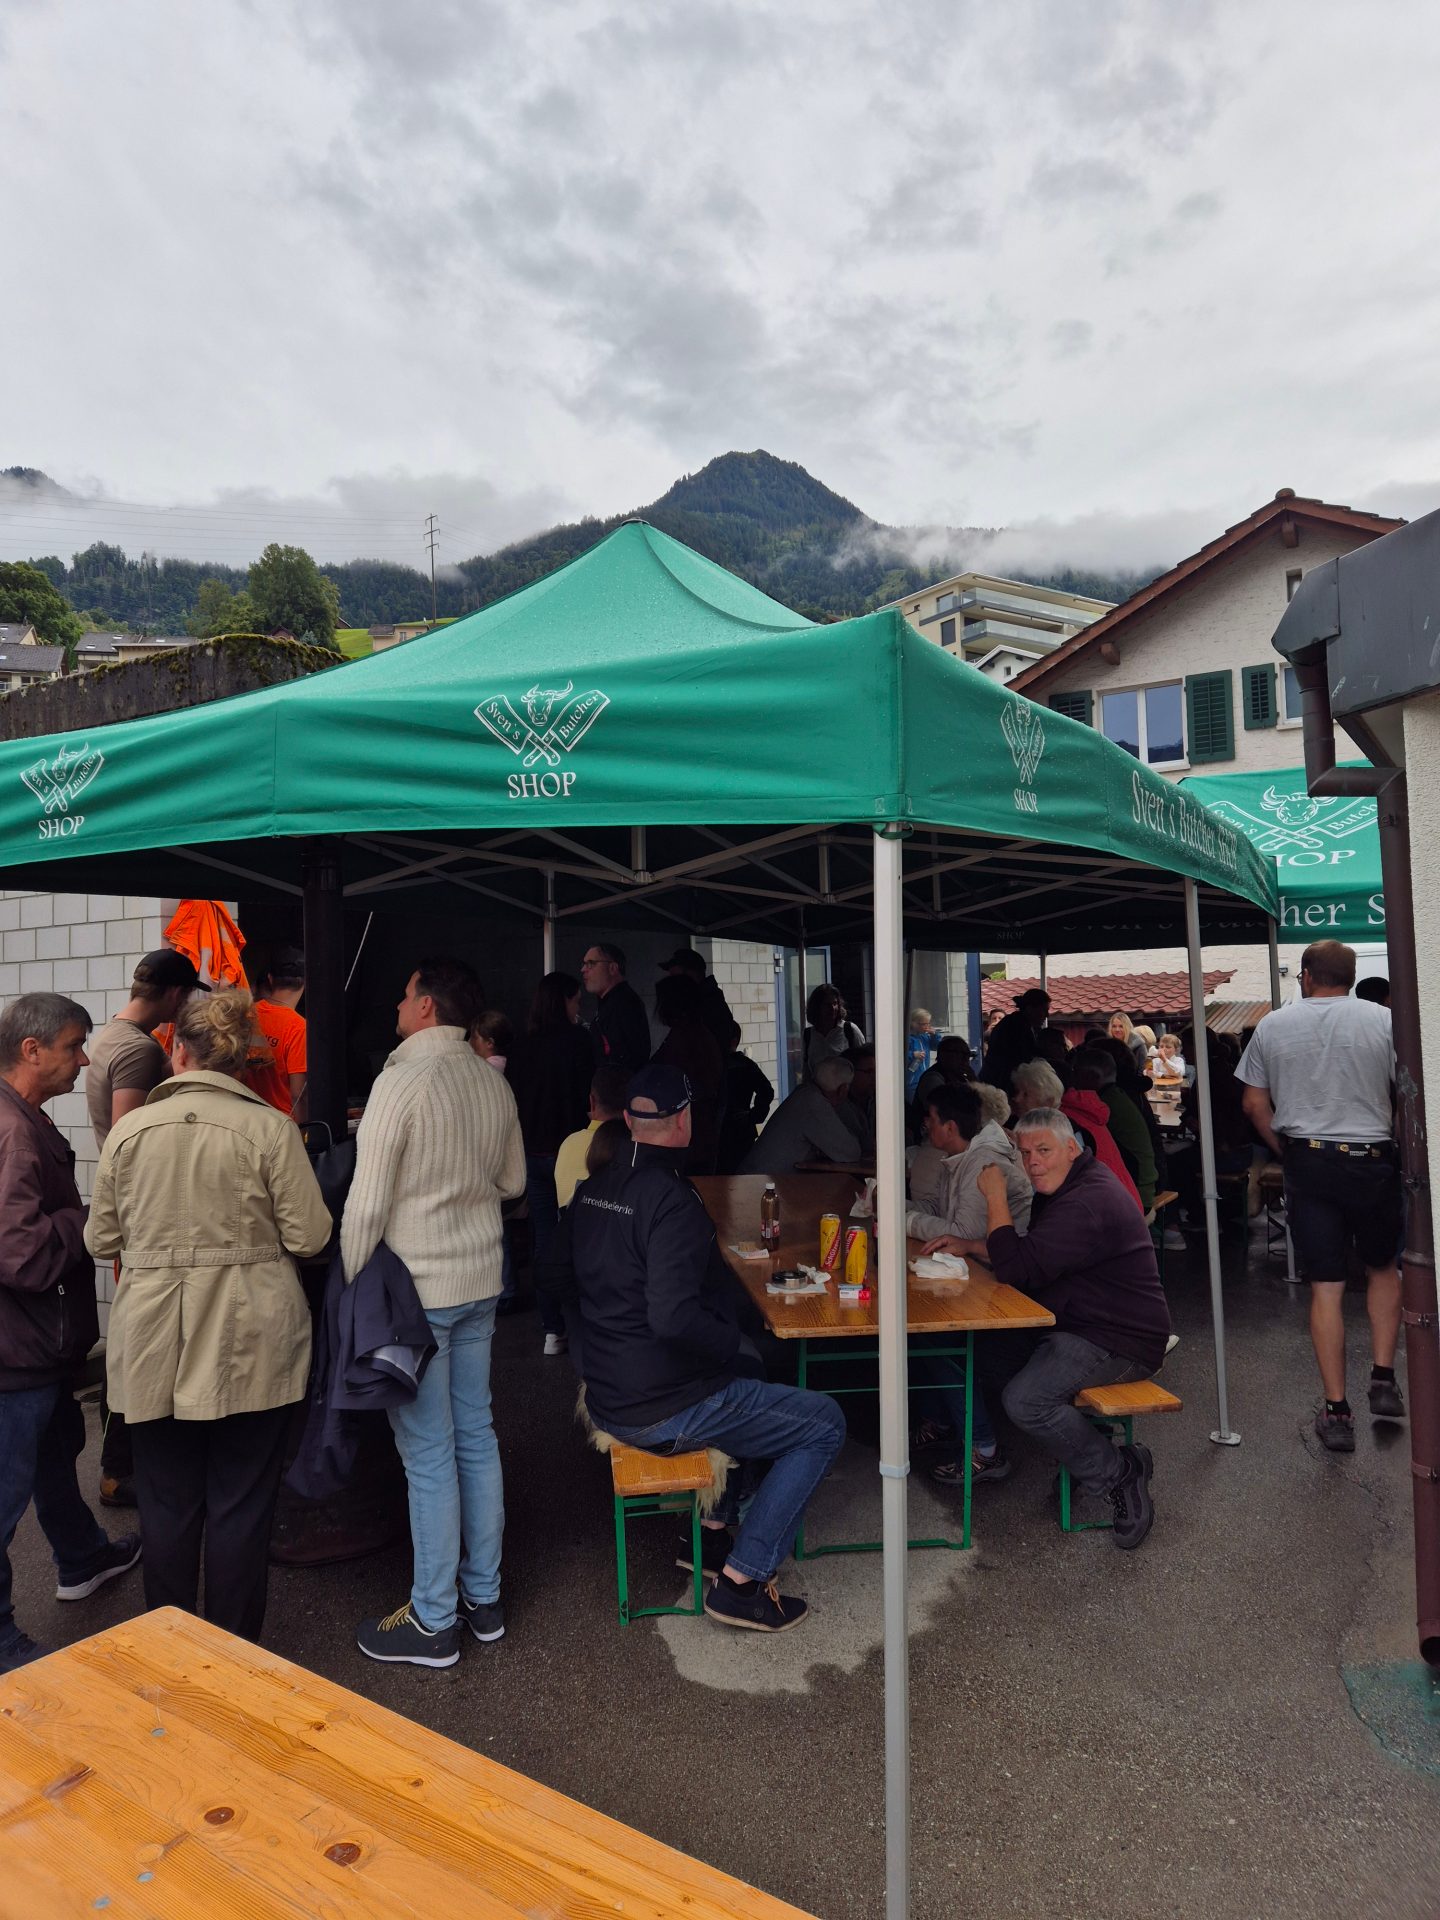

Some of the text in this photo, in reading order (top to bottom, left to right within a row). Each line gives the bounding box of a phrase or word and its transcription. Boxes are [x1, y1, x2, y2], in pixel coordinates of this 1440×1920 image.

[559, 694, 599, 739] Butcher
[507, 771, 577, 799] SHOP
[1014, 788, 1039, 813] SHOP
[38, 815, 85, 840] SHOP
[1326, 802, 1378, 831] Butch
